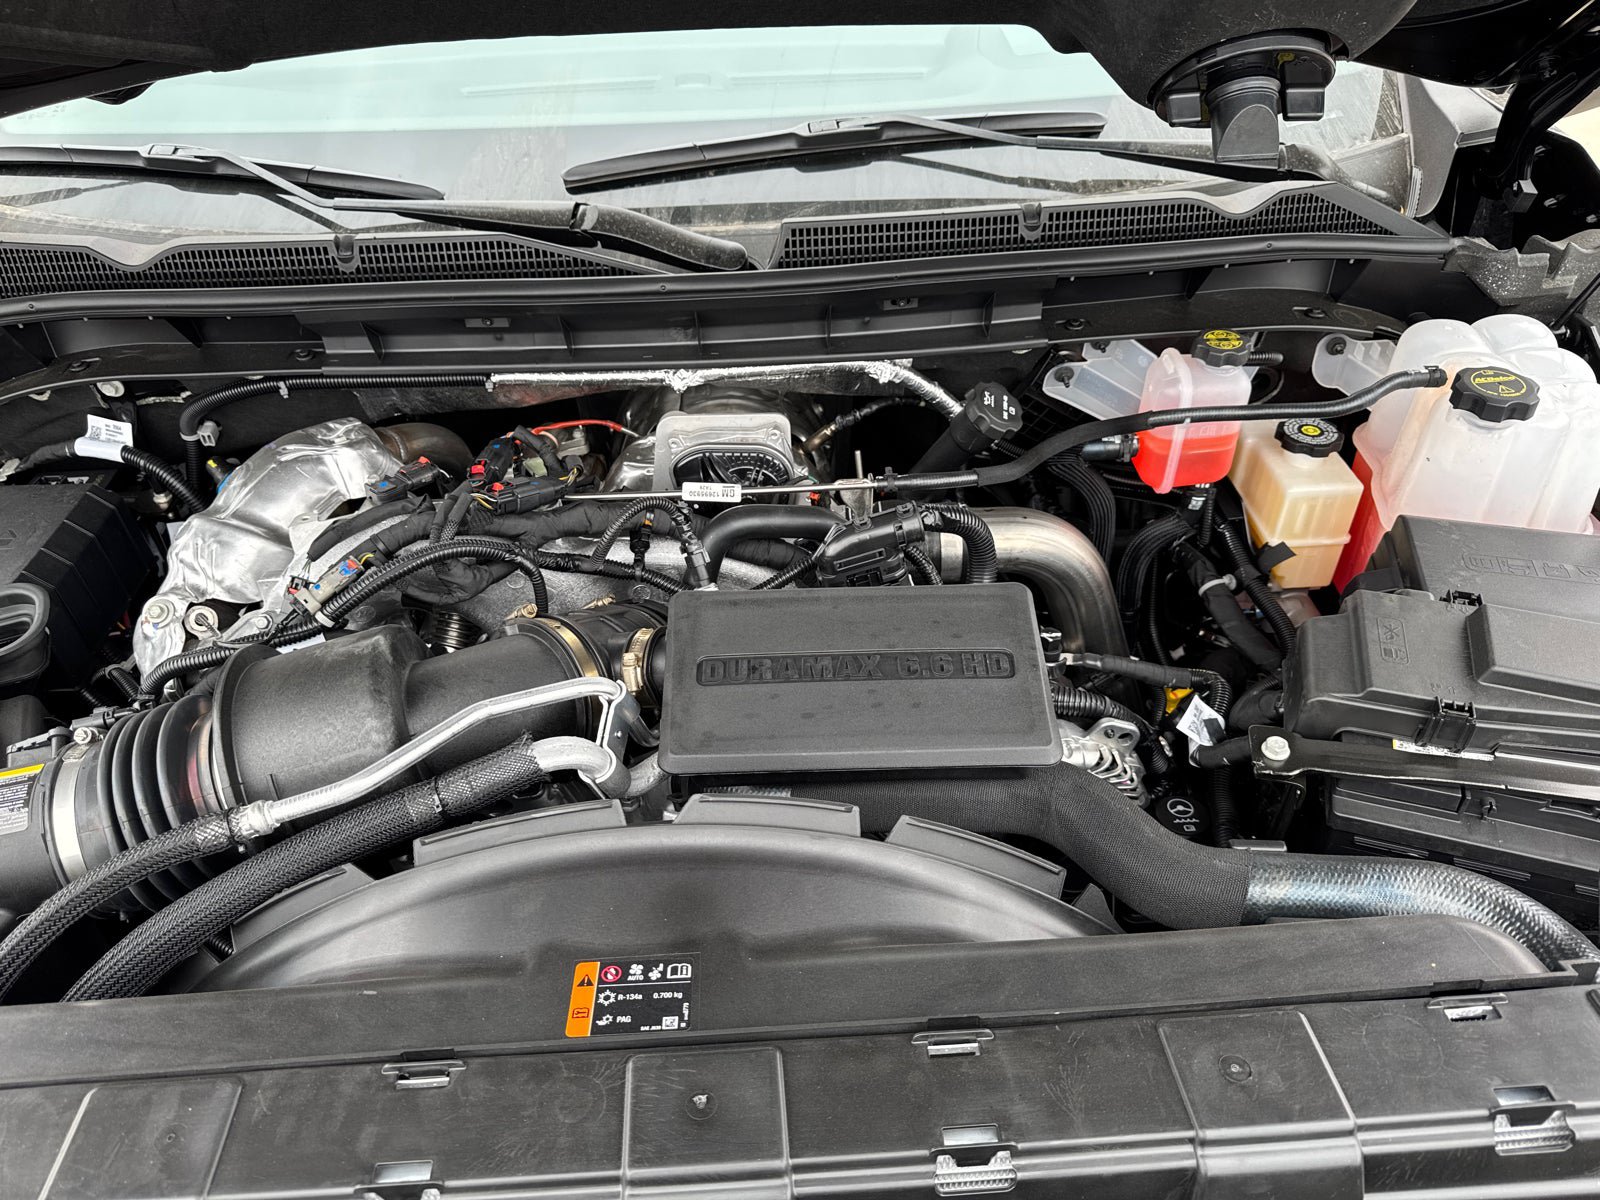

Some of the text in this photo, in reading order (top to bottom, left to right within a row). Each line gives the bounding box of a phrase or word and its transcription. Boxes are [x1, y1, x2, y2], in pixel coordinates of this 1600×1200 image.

[722, 489, 735, 497] GM
[700, 651, 1010, 684] DURAMAX 6.6 HD
[673, 991, 683, 1000] kg
[616, 1015, 632, 1023] PAG
